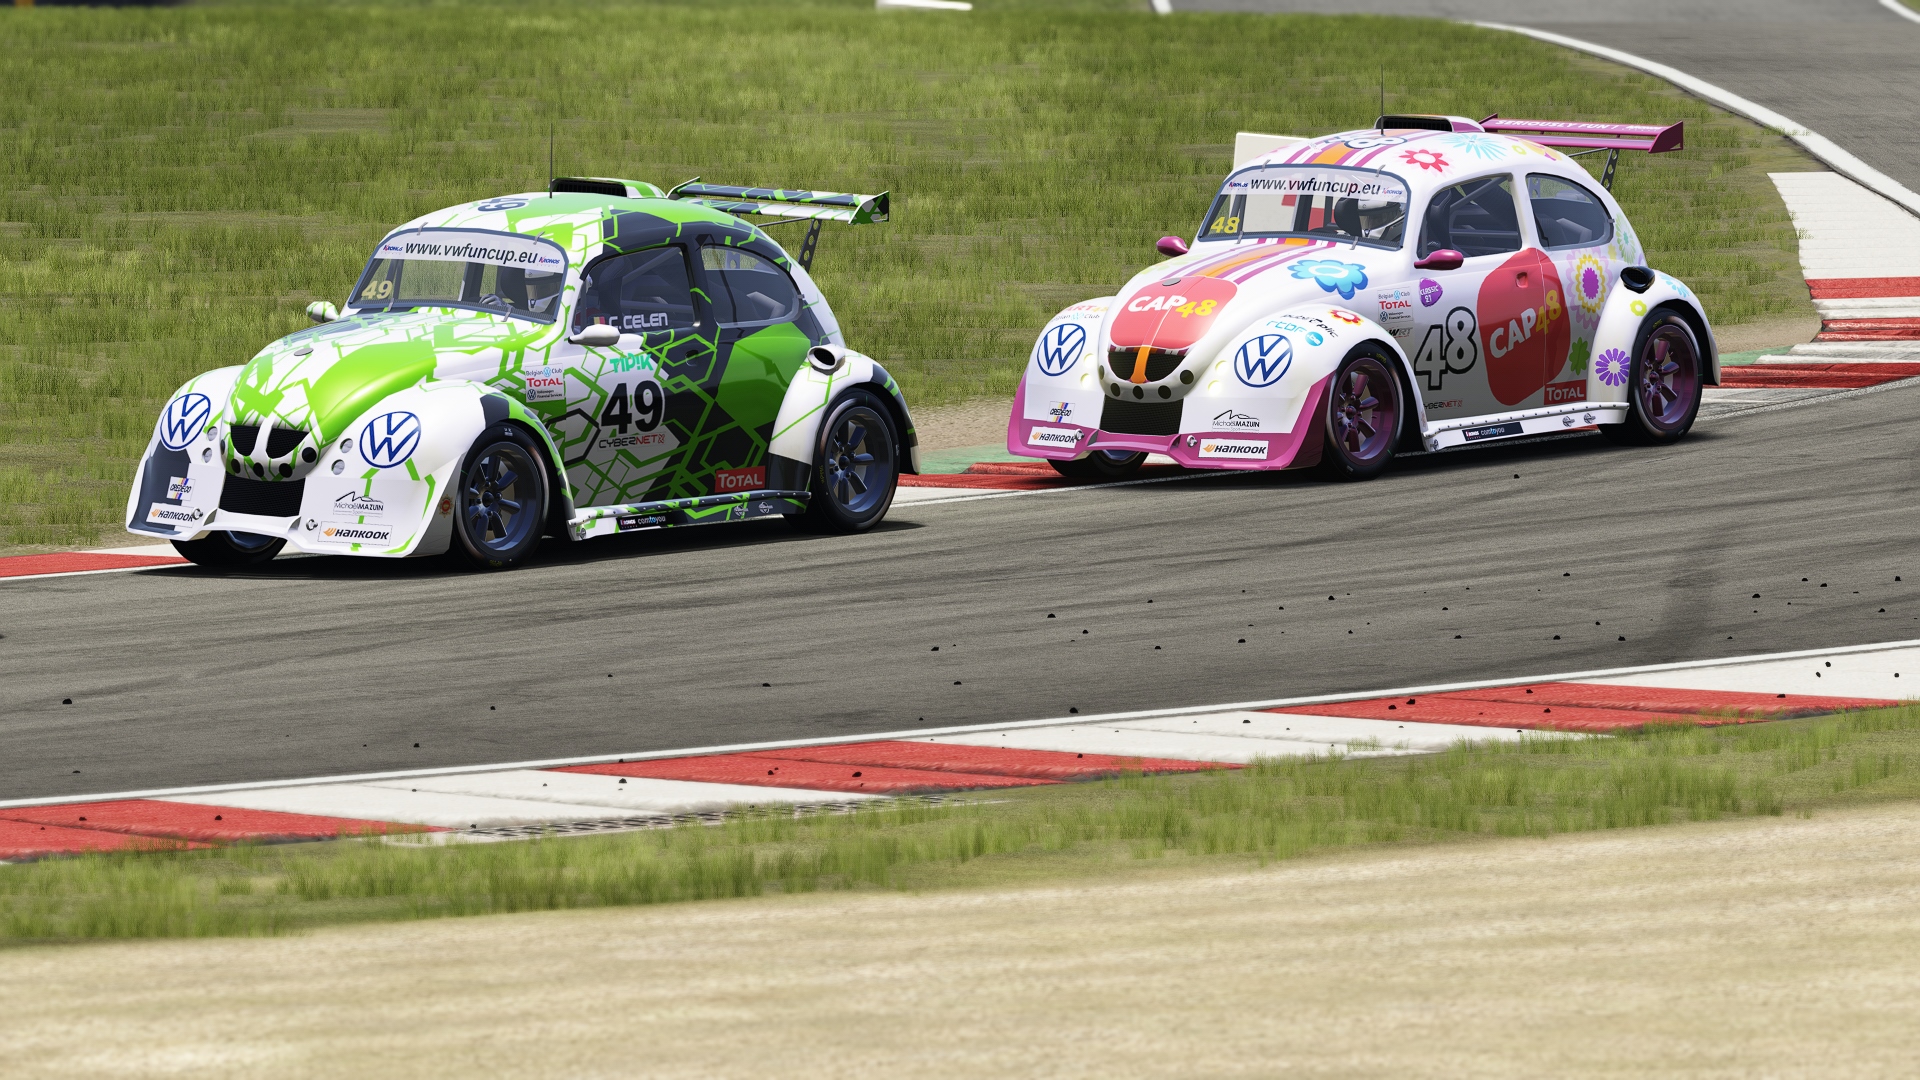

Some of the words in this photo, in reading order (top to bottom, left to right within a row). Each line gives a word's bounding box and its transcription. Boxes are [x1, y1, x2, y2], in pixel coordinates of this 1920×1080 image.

[1495, 120, 1577, 128] SERIOUSLY
[1250, 178, 1381, 196] www.vwfuncup.eu
[1210, 217, 1240, 234] 48
[405, 242, 538, 265] www.vwfuncup.eu
[361, 280, 393, 300] 49
[1490, 289, 1562, 358] CAP48
[1414, 306, 1478, 391] 48
[526, 369, 543, 377] Belgian
[526, 378, 563, 387] TOTAL
[1547, 387, 1585, 401] TOTAL
[601, 380, 664, 435] 49
[718, 473, 763, 488] TOTAL
